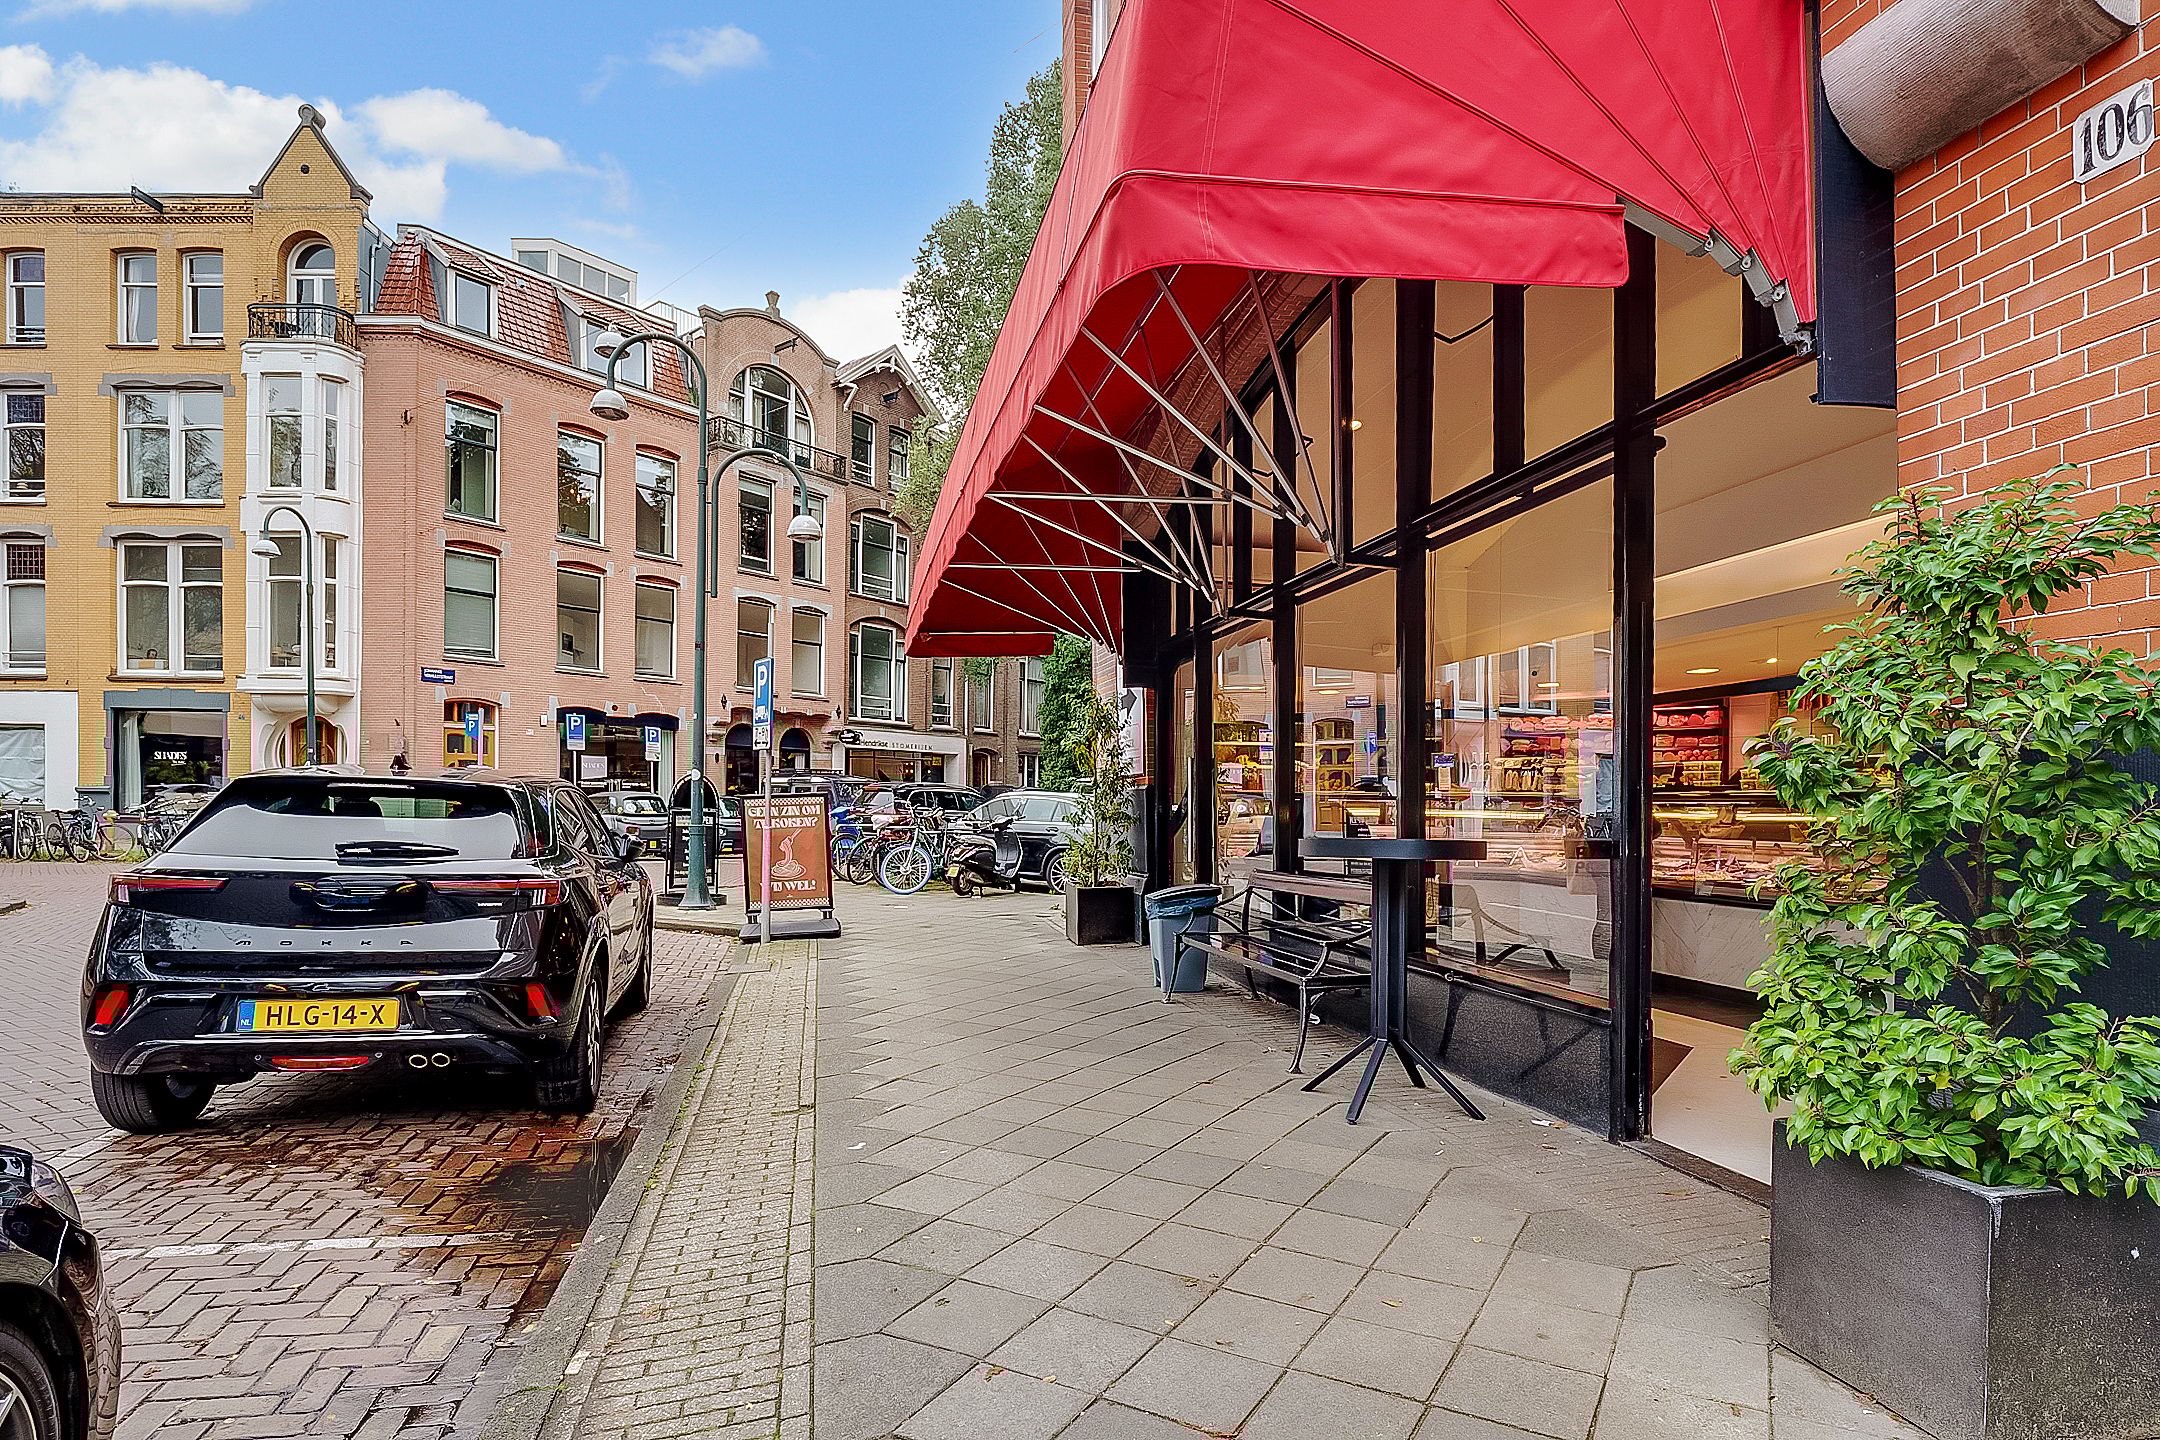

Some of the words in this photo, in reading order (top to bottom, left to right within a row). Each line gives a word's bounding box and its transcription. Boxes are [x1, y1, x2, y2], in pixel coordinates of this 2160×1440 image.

[2079, 83, 2153, 176] 106
[757, 664, 768, 699] P
[468, 720, 476, 732] P
[570, 716, 581, 731] P
[649, 729, 657, 742] P
[891, 742, 933, 751] STOMERIJEN
[153, 751, 188, 760] SHADES
[748, 806, 780, 817] GEN
[780, 805, 800, 816] ZIN
[801, 804, 821, 816] OM
[771, 816, 819, 829] KOKEN?
[784, 880, 817, 891] WEL!
[240, 1018, 252, 1026] NL
[266, 1004, 385, 1027] HLG-14-X
